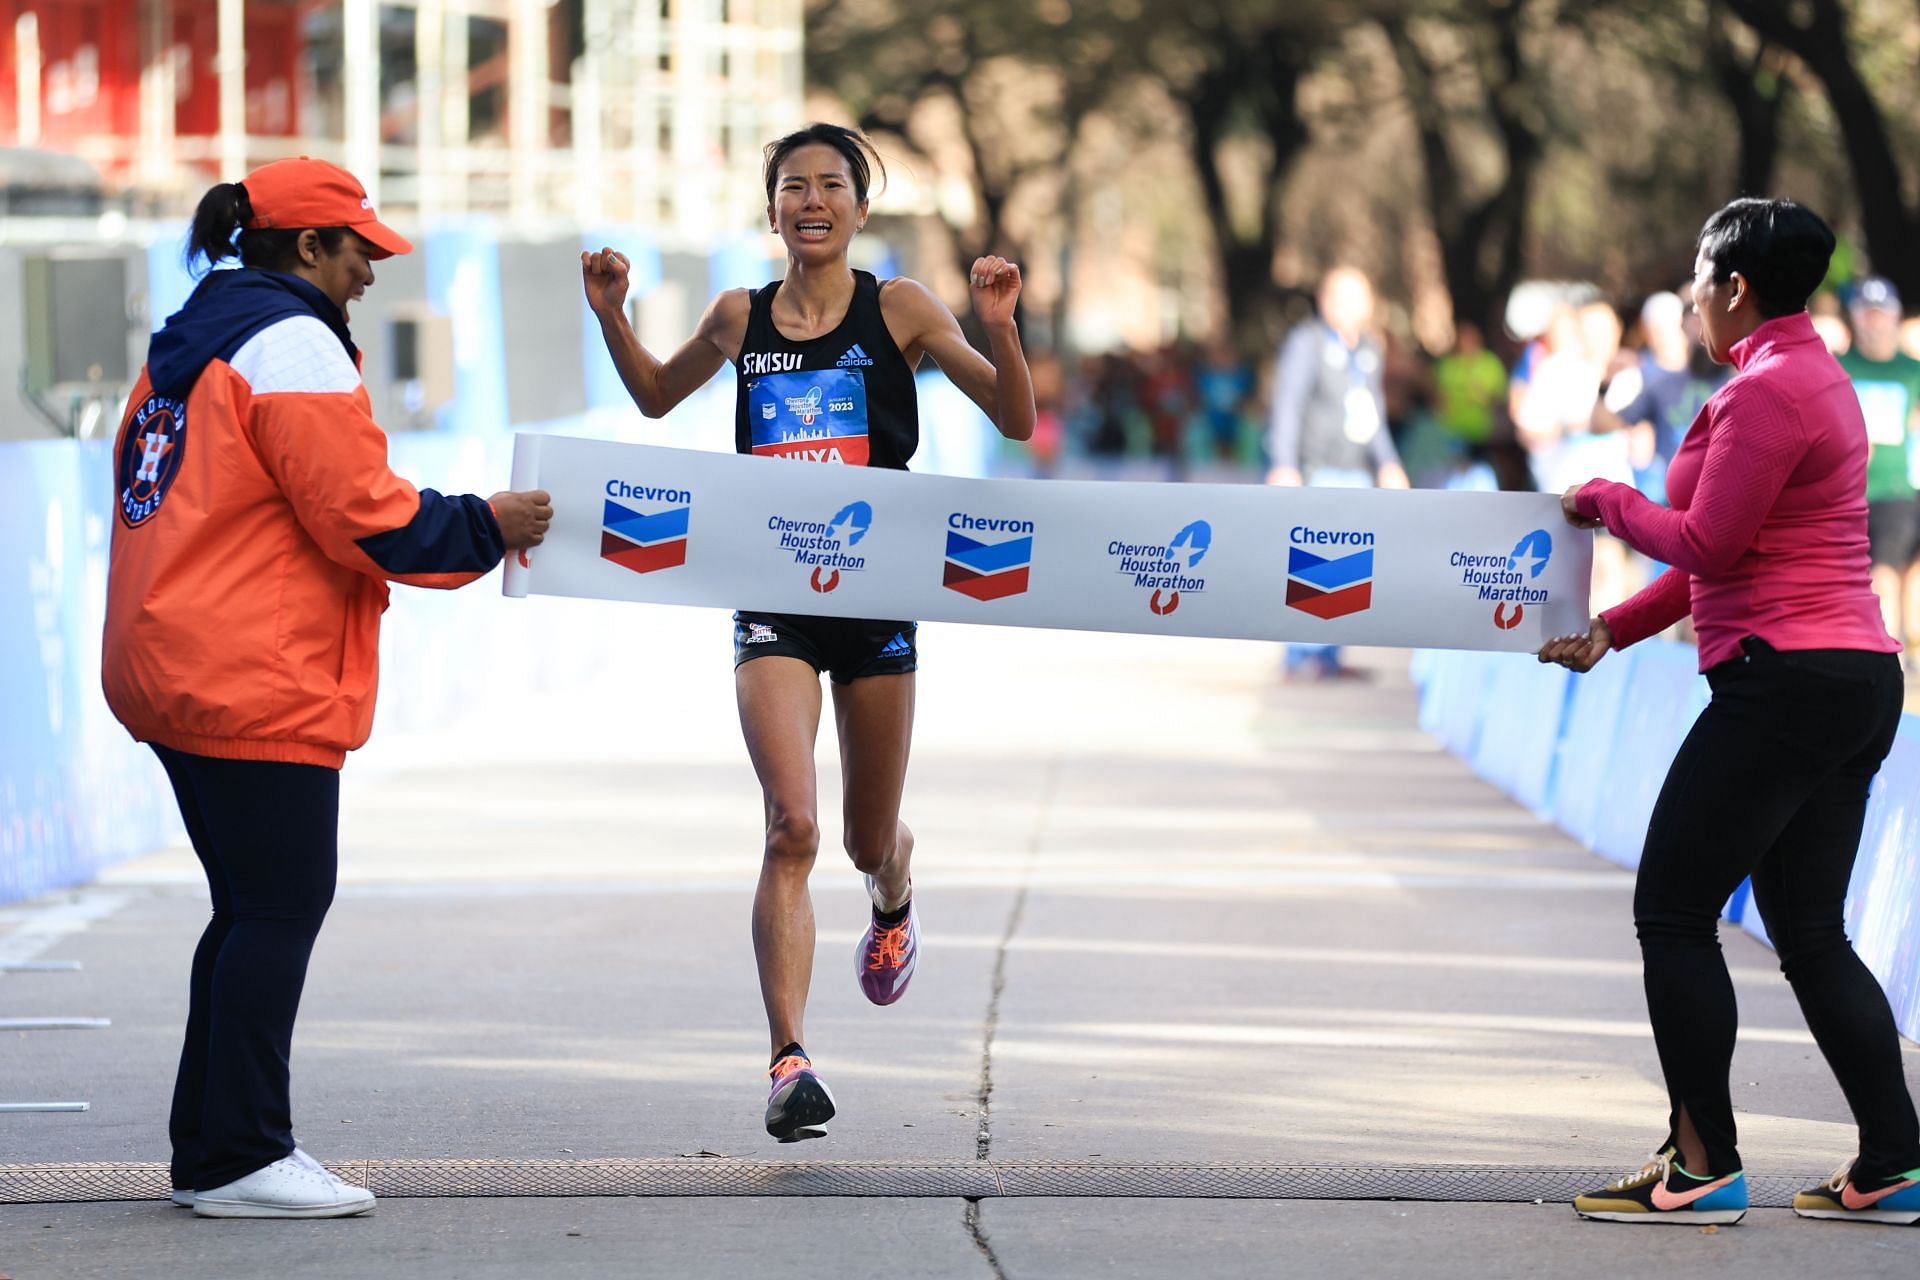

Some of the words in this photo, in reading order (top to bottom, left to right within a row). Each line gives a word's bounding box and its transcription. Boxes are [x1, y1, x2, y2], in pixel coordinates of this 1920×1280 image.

[836, 356, 874, 367] adidas
[828, 402, 854, 412] 2023
[136, 432, 169, 482] H
[606, 480, 691, 504] Chevron
[122, 488, 161, 520] ASTROS
[768, 516, 826, 534] Chevron
[948, 513, 1034, 533] Chevron
[780, 532, 841, 551] Houston
[1290, 526, 1375, 546] Chevron
[1108, 541, 1166, 558] Chevron
[795, 550, 865, 568] Marathon
[1119, 557, 1181, 573] Houston
[1450, 552, 1507, 568] Chevron
[1134, 574, 1205, 590] Marathon
[1462, 568, 1523, 585] Houston
[1478, 586, 1549, 602] Marathon
